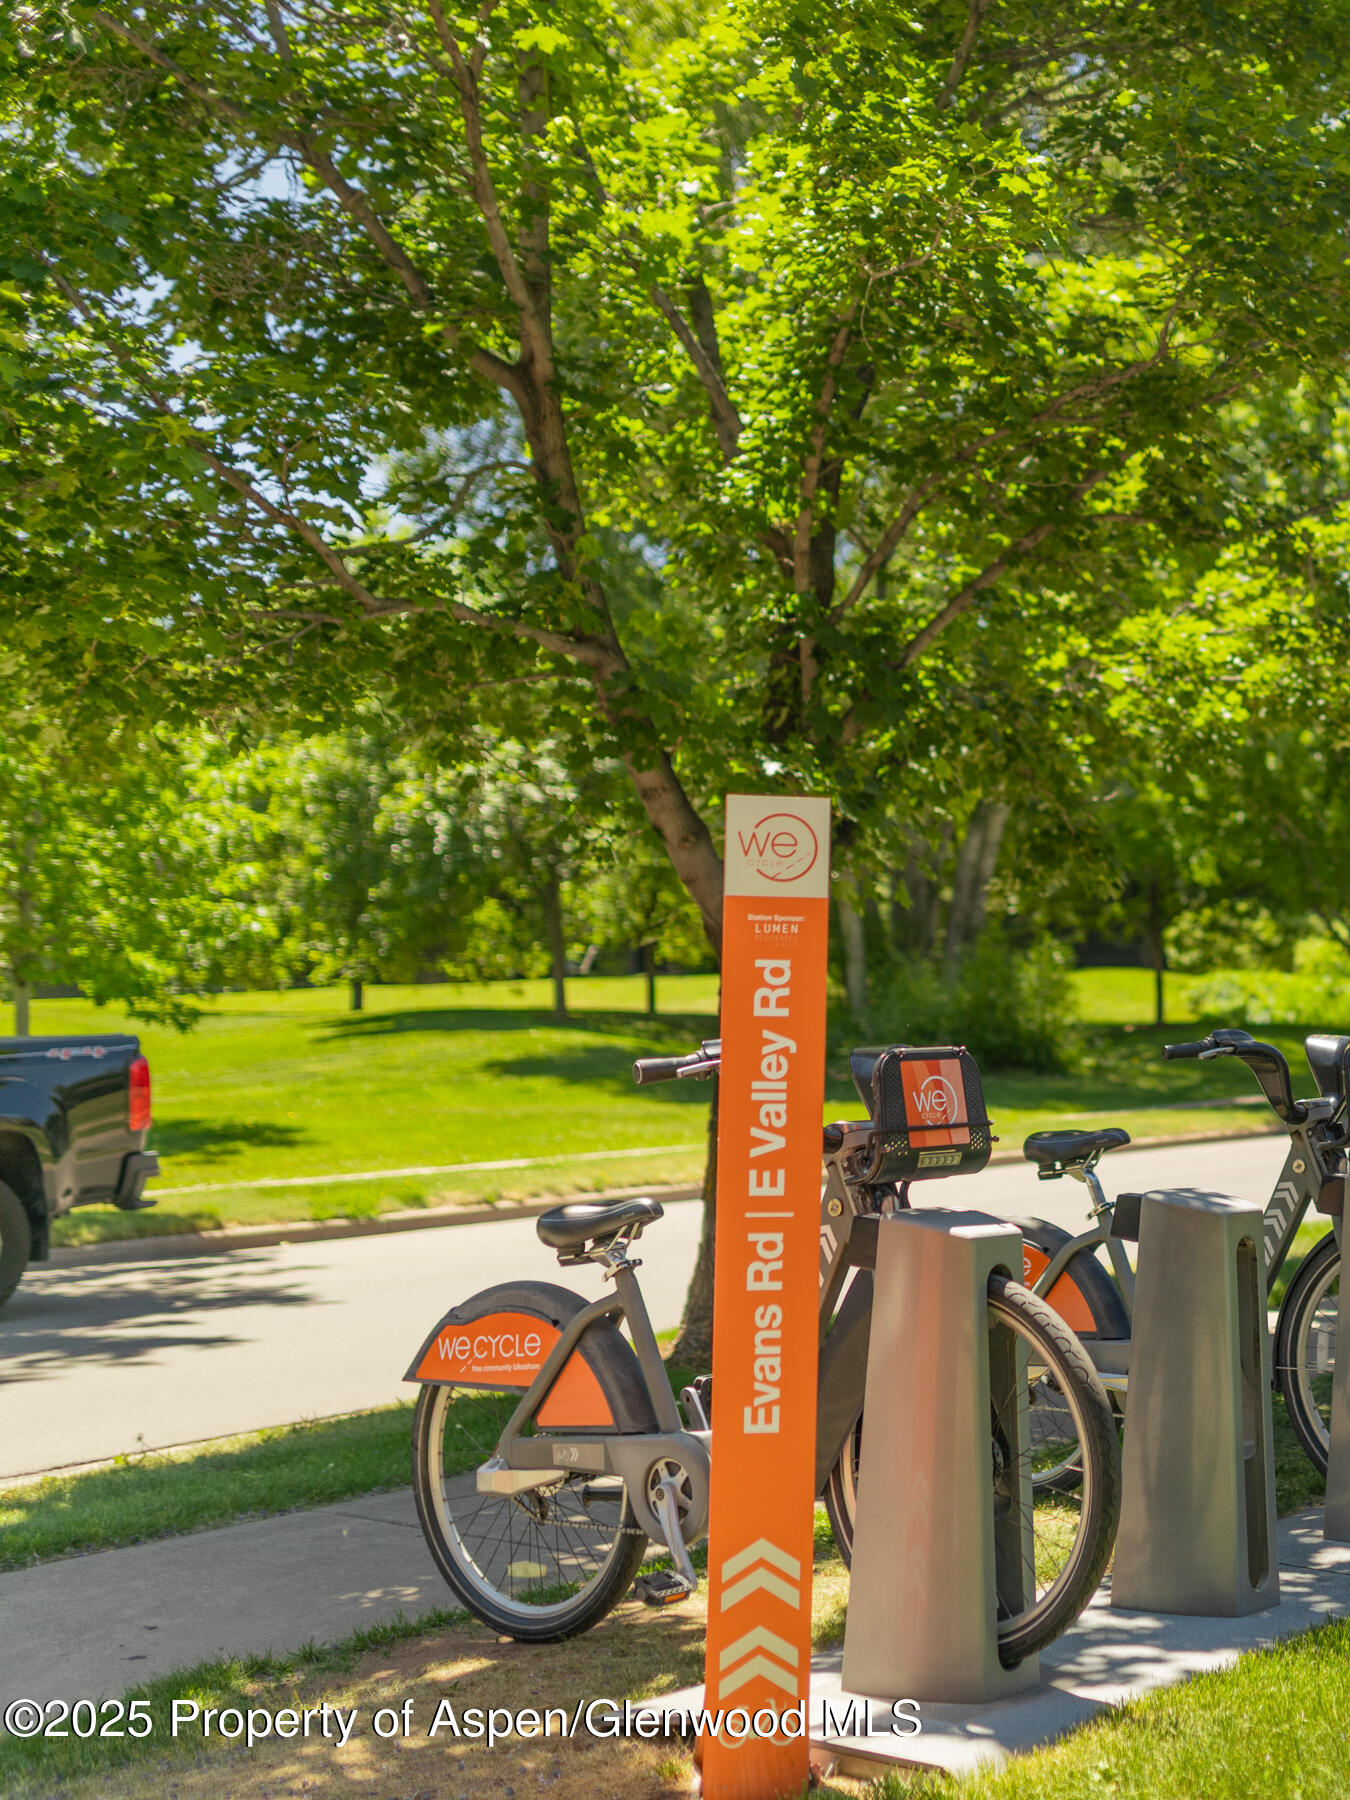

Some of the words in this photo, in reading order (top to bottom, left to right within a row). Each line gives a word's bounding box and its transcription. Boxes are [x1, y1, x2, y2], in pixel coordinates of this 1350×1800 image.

[754, 923, 799, 934] LUMEN
[753, 958, 792, 1018] Rd
[749, 1029, 798, 1158] Valley
[748, 1168, 786, 1197] E
[746, 1232, 785, 1292] Rd
[482, 1363, 512, 1373] community
[512, 1362, 540, 1371] bikeshare
[743, 1303, 783, 1435] Evans
